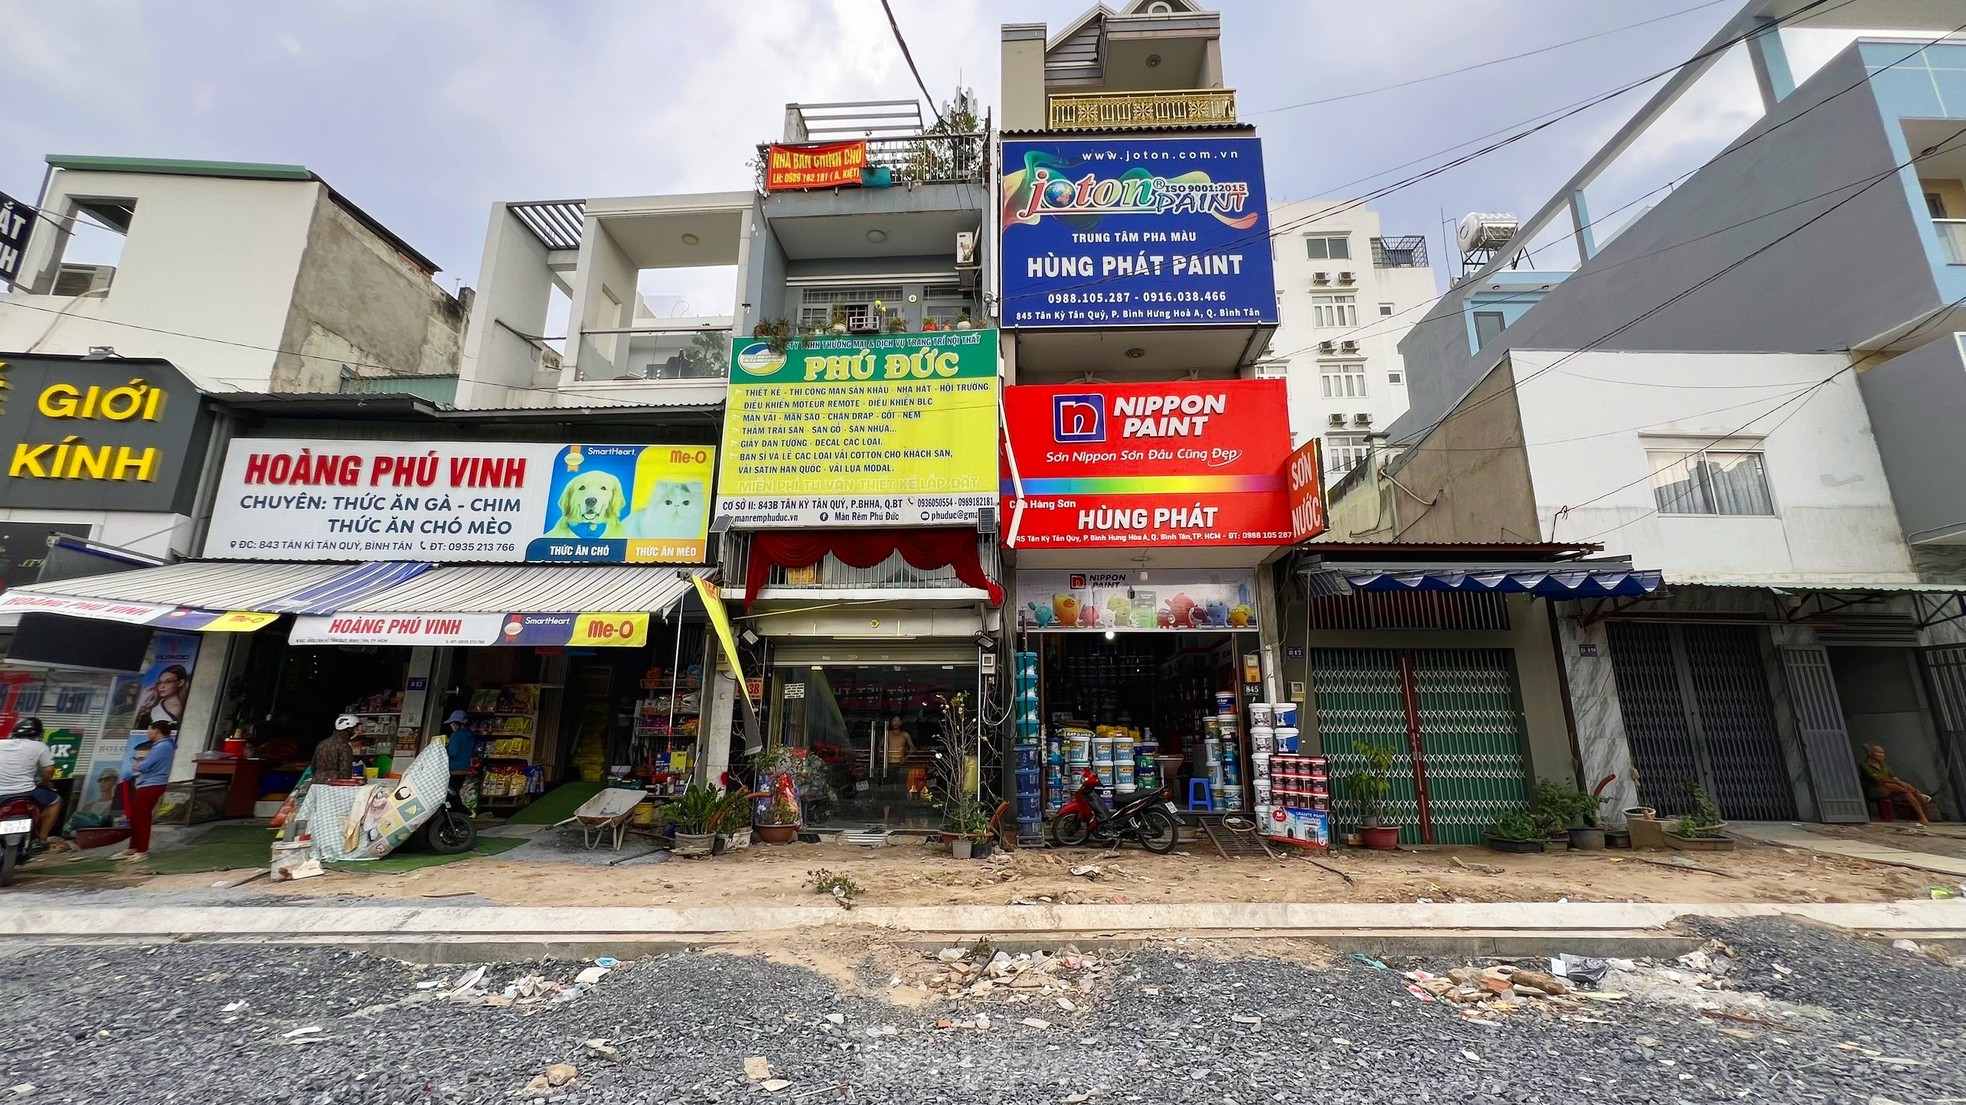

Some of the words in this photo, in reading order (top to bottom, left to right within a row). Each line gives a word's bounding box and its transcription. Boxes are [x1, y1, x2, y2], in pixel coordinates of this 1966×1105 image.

[1082, 150, 1239, 162] www.joton.com.vn
[1018, 171, 1153, 218] joton
[1165, 183, 1187, 193] ISO
[1188, 182, 1246, 193] 9001:2015
[1155, 192, 1248, 214] PAINT
[1072, 232, 1110, 243] TRUNG
[1114, 230, 1139, 242] TÂM
[1143, 232, 1167, 242] PHA
[1171, 230, 1197, 242] MÀU
[1027, 252, 1094, 278] HÙNG
[1102, 250, 1164, 276] PHÁT
[1173, 254, 1243, 275] PAINT
[1048, 292, 1130, 304] 0988.105.287
[1143, 291, 1226, 302] 0916.038.466
[1016, 311, 1032, 320] 845
[1035, 311, 1051, 320] Tân
[1068, 310, 1085, 319] Tân
[1111, 310, 1119, 319] P.
[1122, 309, 1144, 318] Bình
[1146, 309, 1170, 320] Hưng
[1173, 308, 1191, 318] Hoà
[1193, 309, 1203, 319] A,
[1206, 308, 1216, 318] Q.
[1219, 308, 1241, 317] Bình
[1243, 307, 1260, 317] Tân
[907, 338, 931, 347] TRANG
[932, 335, 946, 346] TRÍ
[947, 334, 960, 346] NỘI
[961, 332, 981, 345] THẤT
[804, 348, 876, 381] PHÚ
[884, 346, 959, 379] ĐỨC
[790, 388, 802, 396] THI
[38, 378, 164, 421] GIỚI
[792, 400, 825, 408] MOTEUR
[827, 400, 860, 408] REMOTE
[917, 398, 933, 406] BLC
[1113, 394, 1226, 417] NIPPON
[852, 411, 874, 420] DRAP
[1122, 415, 1209, 438] PAINT
[815, 438, 840, 447] DECAL
[9, 435, 158, 481] KÍNH
[588, 447, 635, 456] SmartHeart
[670, 449, 707, 464] Me-O
[850, 451, 882, 459] COTTON
[1046, 452, 1069, 463] Sơn
[1072, 451, 1117, 464] Nippon
[1120, 450, 1144, 461] Sơn
[1148, 449, 1173, 460] Đâu
[1177, 448, 1208, 461] Cũng
[1212, 447, 1238, 461] Đẹp
[243, 448, 363, 487] HOÀNG
[370, 450, 438, 488] PHÚ
[450, 457, 527, 489] VINH
[754, 465, 777, 474] SATIN
[863, 464, 895, 472] MODAL.
[1291, 451, 1313, 491] SƠN
[240, 492, 327, 510] CHUYÊN:
[333, 492, 386, 510] THỨC
[390, 494, 419, 511] ĂN
[424, 494, 452, 511] GÀ
[470, 498, 521, 512] CHIM
[758, 500, 779, 510] 843B
[781, 498, 798, 510] TÂN
[812, 498, 828, 510] TÂN
[884, 499, 903, 509] Q.BT
[1030, 500, 1055, 510] Hàng
[1057, 499, 1077, 508] Sơn
[852, 512, 868, 520] Rèm
[885, 511, 900, 520] Đức
[1078, 504, 1148, 529] HÙNG
[1153, 502, 1219, 529] PHÁT
[1291, 492, 1321, 538] NƯỚC
[328, 515, 382, 533] THỨC
[385, 516, 415, 533] ĂN
[420, 516, 463, 534] CHÓ
[467, 516, 513, 534] MÈO
[1052, 534, 1065, 542] Tân
[1204, 532, 1221, 540] HCM
[1242, 531, 1261, 539] 0988
[1263, 531, 1277, 539] 105
[1278, 531, 1292, 539] 287
[239, 540, 257, 549] ĐC:
[259, 541, 280, 549] 843
[282, 540, 302, 550] TÂN
[317, 540, 337, 550] TÂN
[338, 540, 362, 551] QUÝ,
[364, 540, 390, 550] BÌNH
[393, 541, 413, 551] TÂN
[430, 543, 446, 551] ĐT:
[449, 543, 475, 551] 0935
[477, 543, 494, 551] 213
[496, 543, 515, 552] 766
[550, 545, 573, 556] THỨC
[575, 545, 589, 556] ĂN
[590, 544, 610, 556] CHÓ
[635, 545, 660, 556] THỨC
[661, 545, 675, 556] ĂN
[676, 544, 697, 556] MÈO
[328, 616, 385, 633] HOÀNG
[387, 616, 421, 634] PHÚ
[425, 619, 462, 634] VINH
[525, 616, 570, 626] SmartHeart
[588, 620, 633, 639] Me-O
